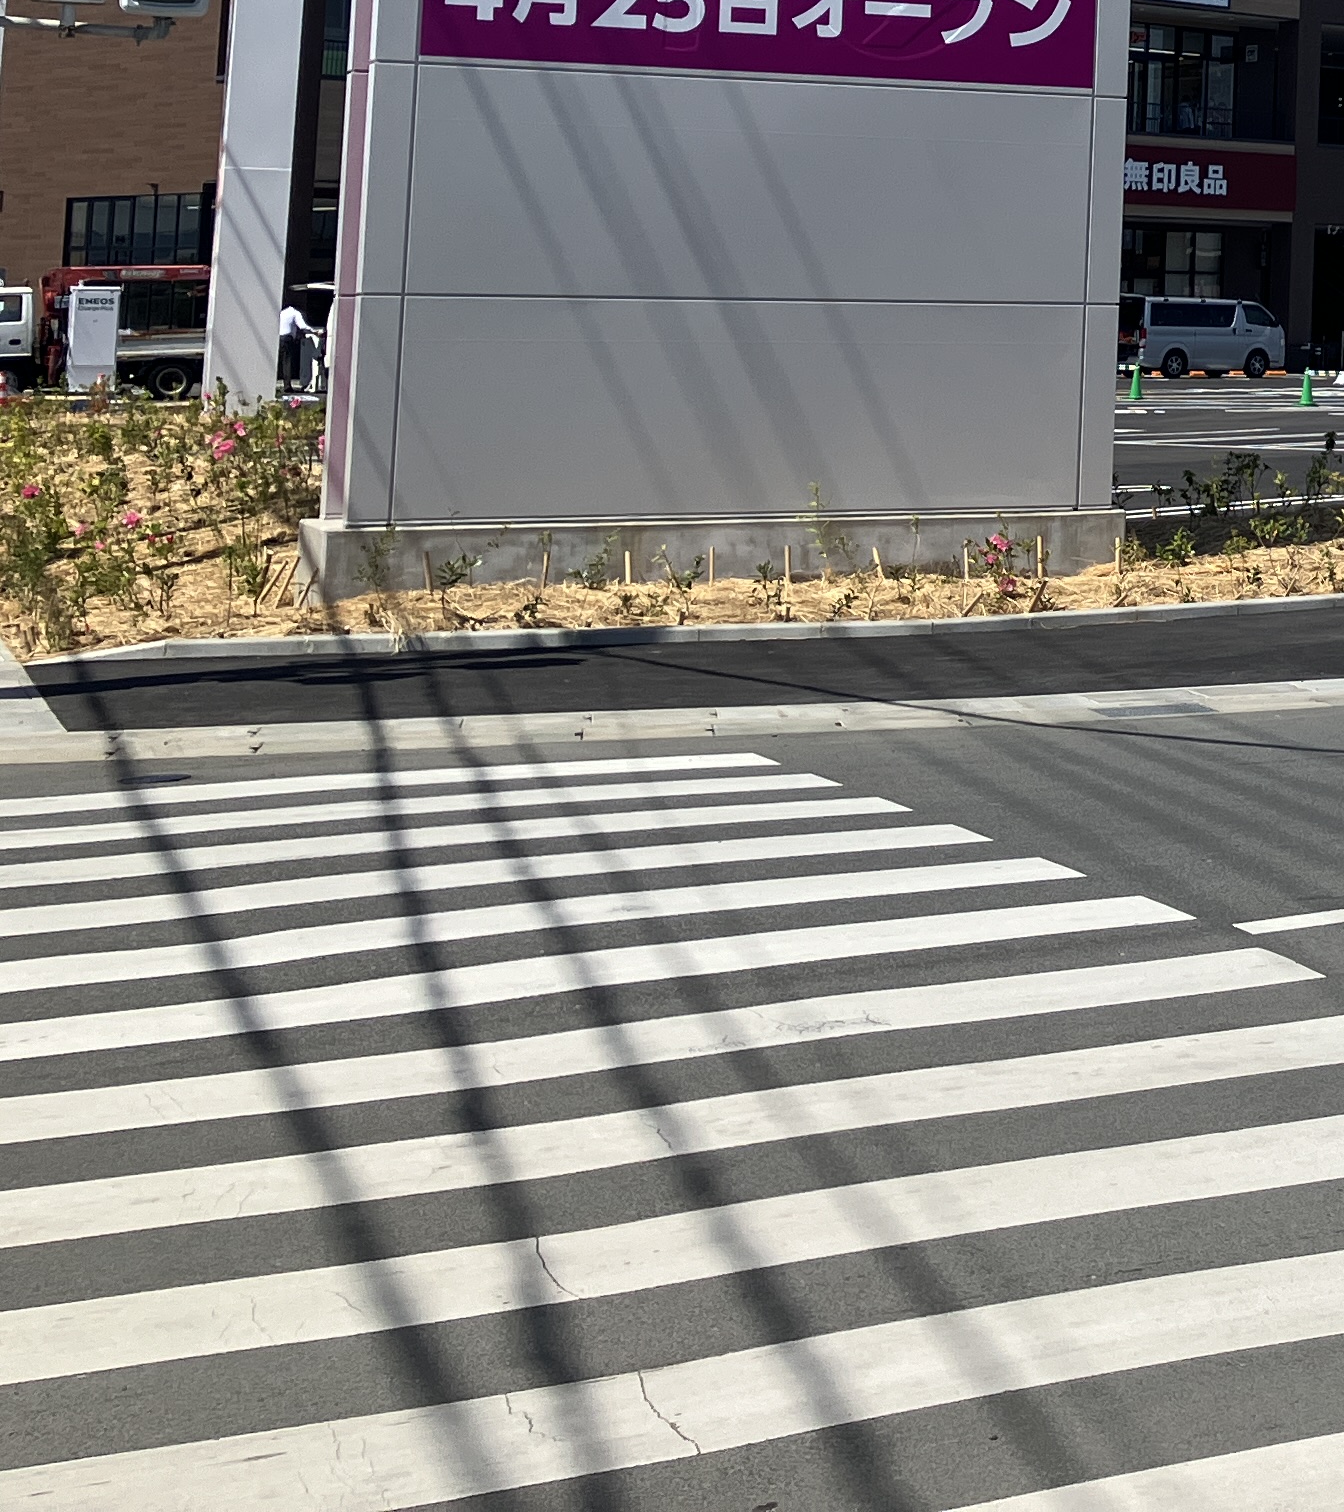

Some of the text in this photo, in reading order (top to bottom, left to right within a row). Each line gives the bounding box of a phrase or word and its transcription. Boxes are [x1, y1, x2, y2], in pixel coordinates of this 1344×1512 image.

[1124, 157, 1227, 196] 無印良品
[78, 297, 115, 305] ENEOS
